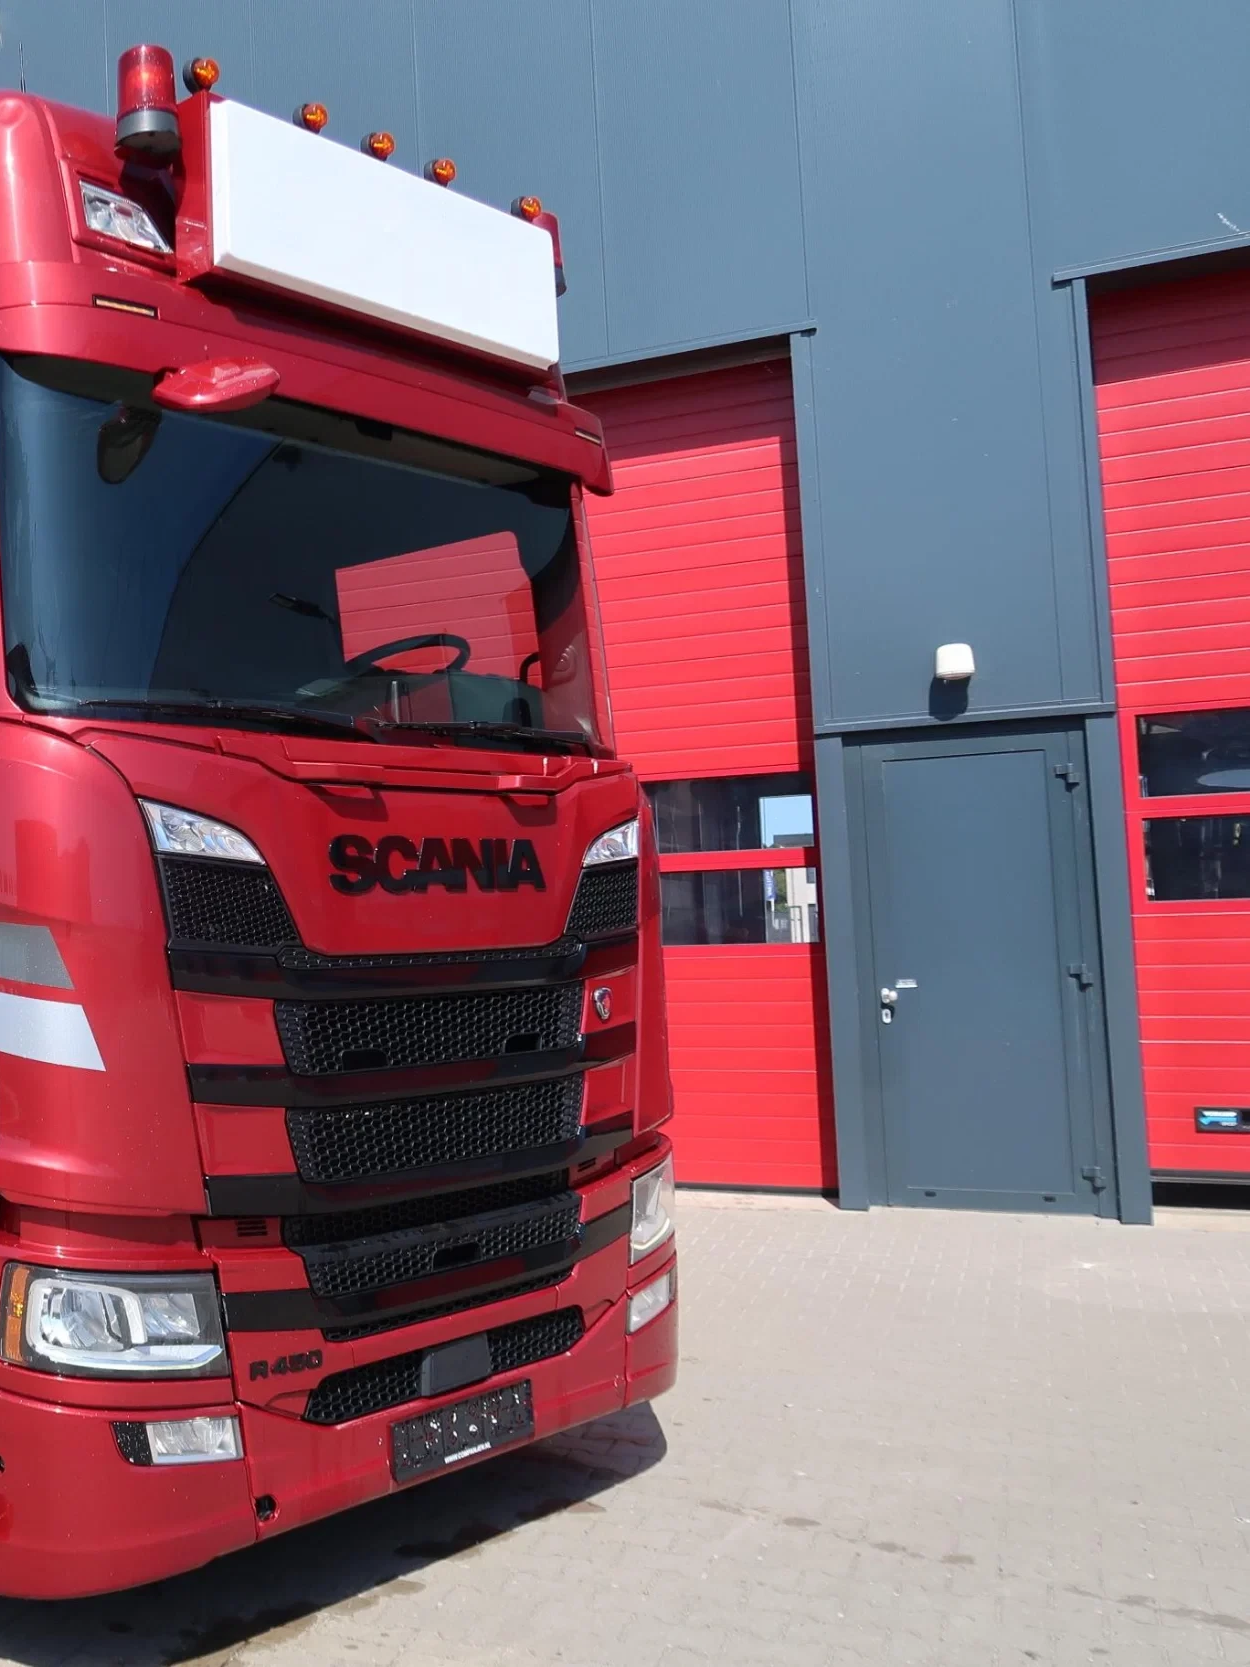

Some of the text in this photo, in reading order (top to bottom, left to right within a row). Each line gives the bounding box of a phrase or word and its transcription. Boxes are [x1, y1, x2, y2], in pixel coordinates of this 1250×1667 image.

[328, 834, 547, 896] SCANIA
[249, 1349, 323, 1382] R 450
